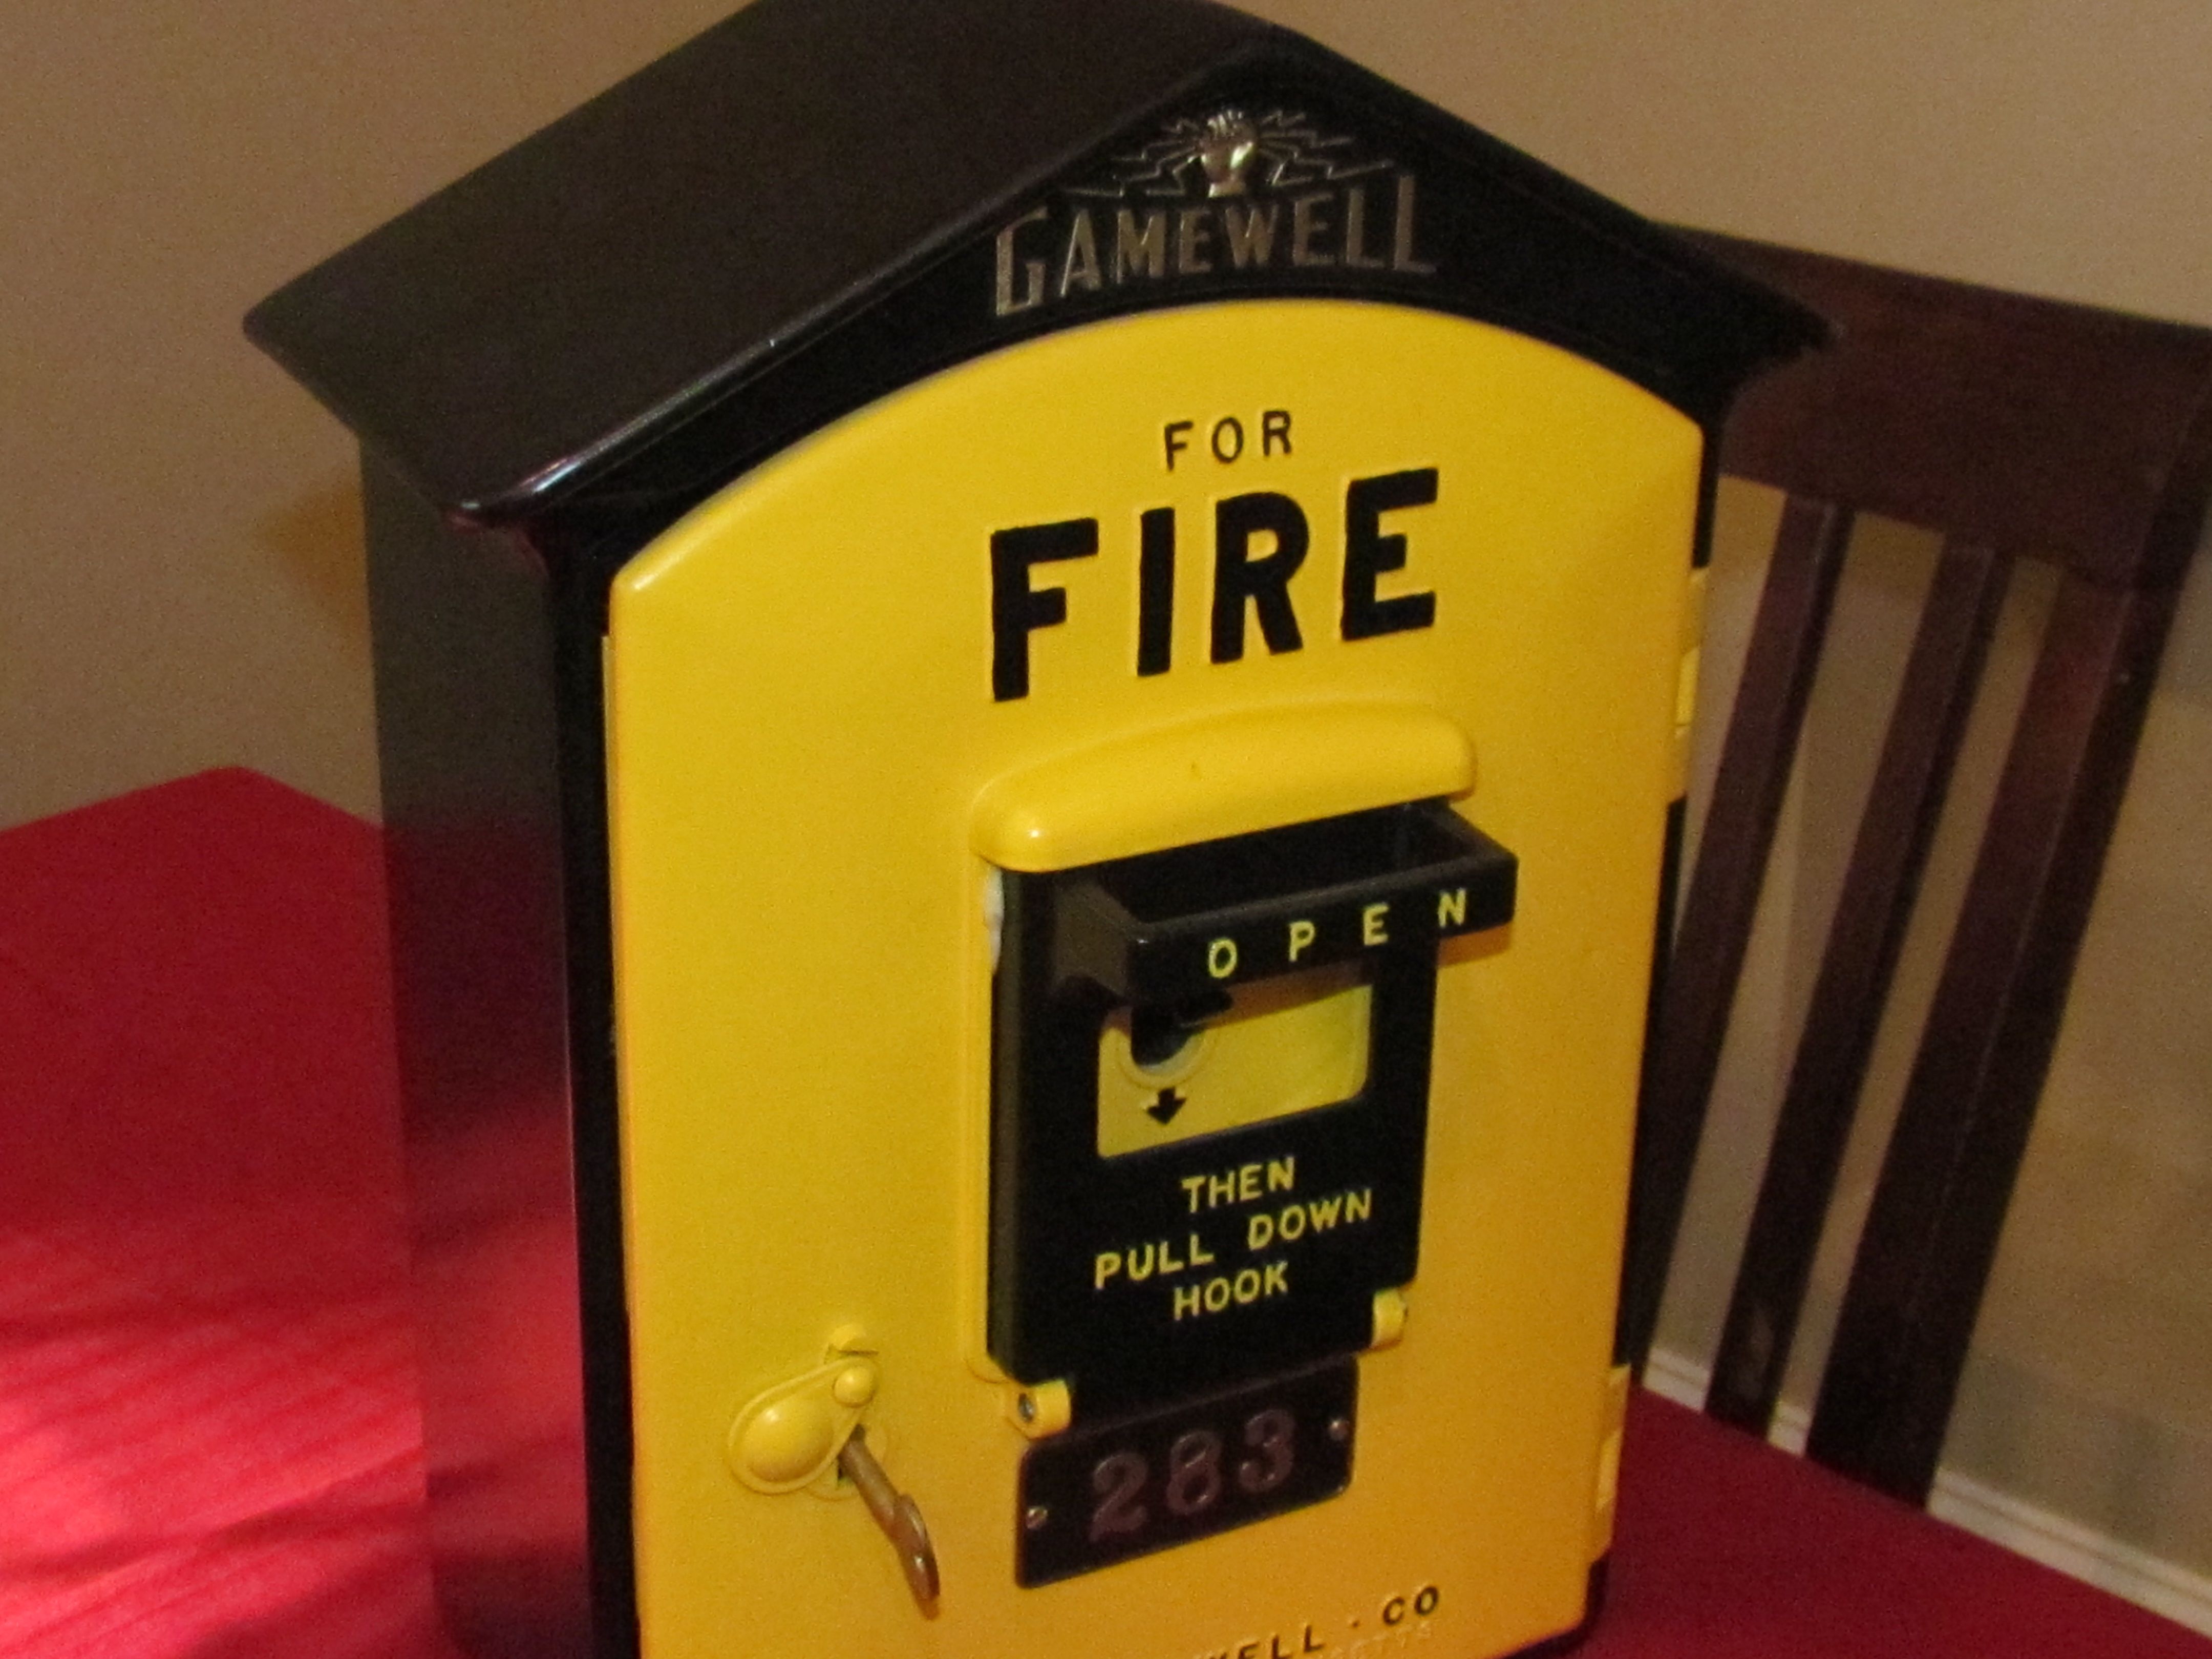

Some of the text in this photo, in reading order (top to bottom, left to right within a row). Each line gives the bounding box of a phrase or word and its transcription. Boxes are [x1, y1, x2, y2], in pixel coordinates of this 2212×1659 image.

[995, 174, 1436, 317] GAMEWELL
[1163, 410, 1292, 471] FOR
[990, 467, 1439, 703] FIRE
[1207, 887, 1467, 979] OPEN
[1181, 1156, 1295, 1214] THEN
[1094, 1188, 1372, 1290] PULL DOWN
[1174, 1261, 1288, 1321] HOOK
[1089, 1408, 1296, 1541] 283
[1198, 1624, 1325, 1659] ELL
[1383, 1585, 1439, 1626] CO
